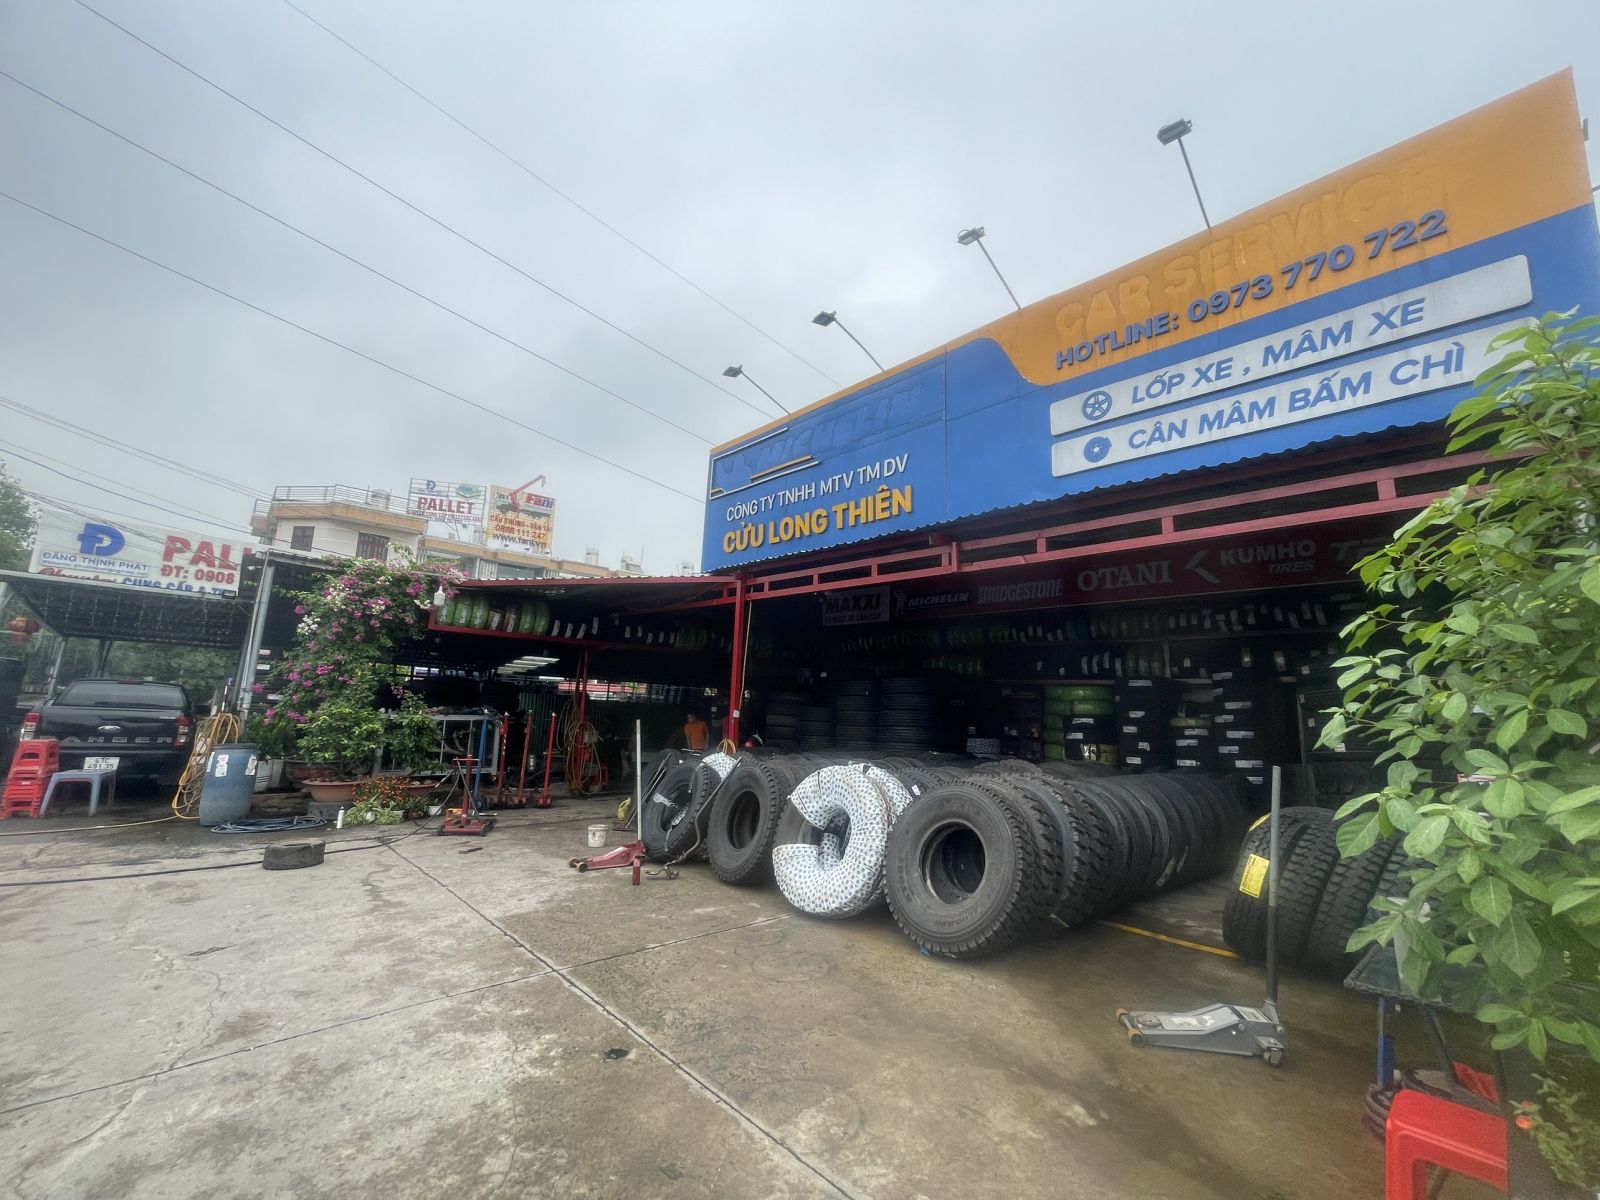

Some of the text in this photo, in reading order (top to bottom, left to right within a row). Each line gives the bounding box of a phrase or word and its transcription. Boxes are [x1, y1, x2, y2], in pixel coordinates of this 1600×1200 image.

[1055, 209, 1448, 370] HOTLINE: 0973 770 722
[1055, 275, 1152, 338] CAR
[1131, 371, 1185, 404] LỐP
[1192, 357, 1234, 388] XE
[1262, 319, 1354, 367] MÂM
[1368, 297, 1425, 337] XE
[1128, 341, 1465, 449] CÂN MÂM BẤM CHÌ
[726, 453, 909, 522] CÔNG TY TNHH MTV TM DV
[417, 496, 475, 514] PALLET
[723, 484, 913, 553] CỬU LONG THIÊN
[1220, 539, 1318, 567] KUMHO
[1267, 559, 1316, 575] TIRES
[161, 564, 188, 579] ĐT:
[1077, 560, 1173, 591] OTANI
[907, 591, 969, 608] MICHELIN
[976, 578, 1064, 605] BRIDGESTONE
[61, 735, 173, 743] ANGER
